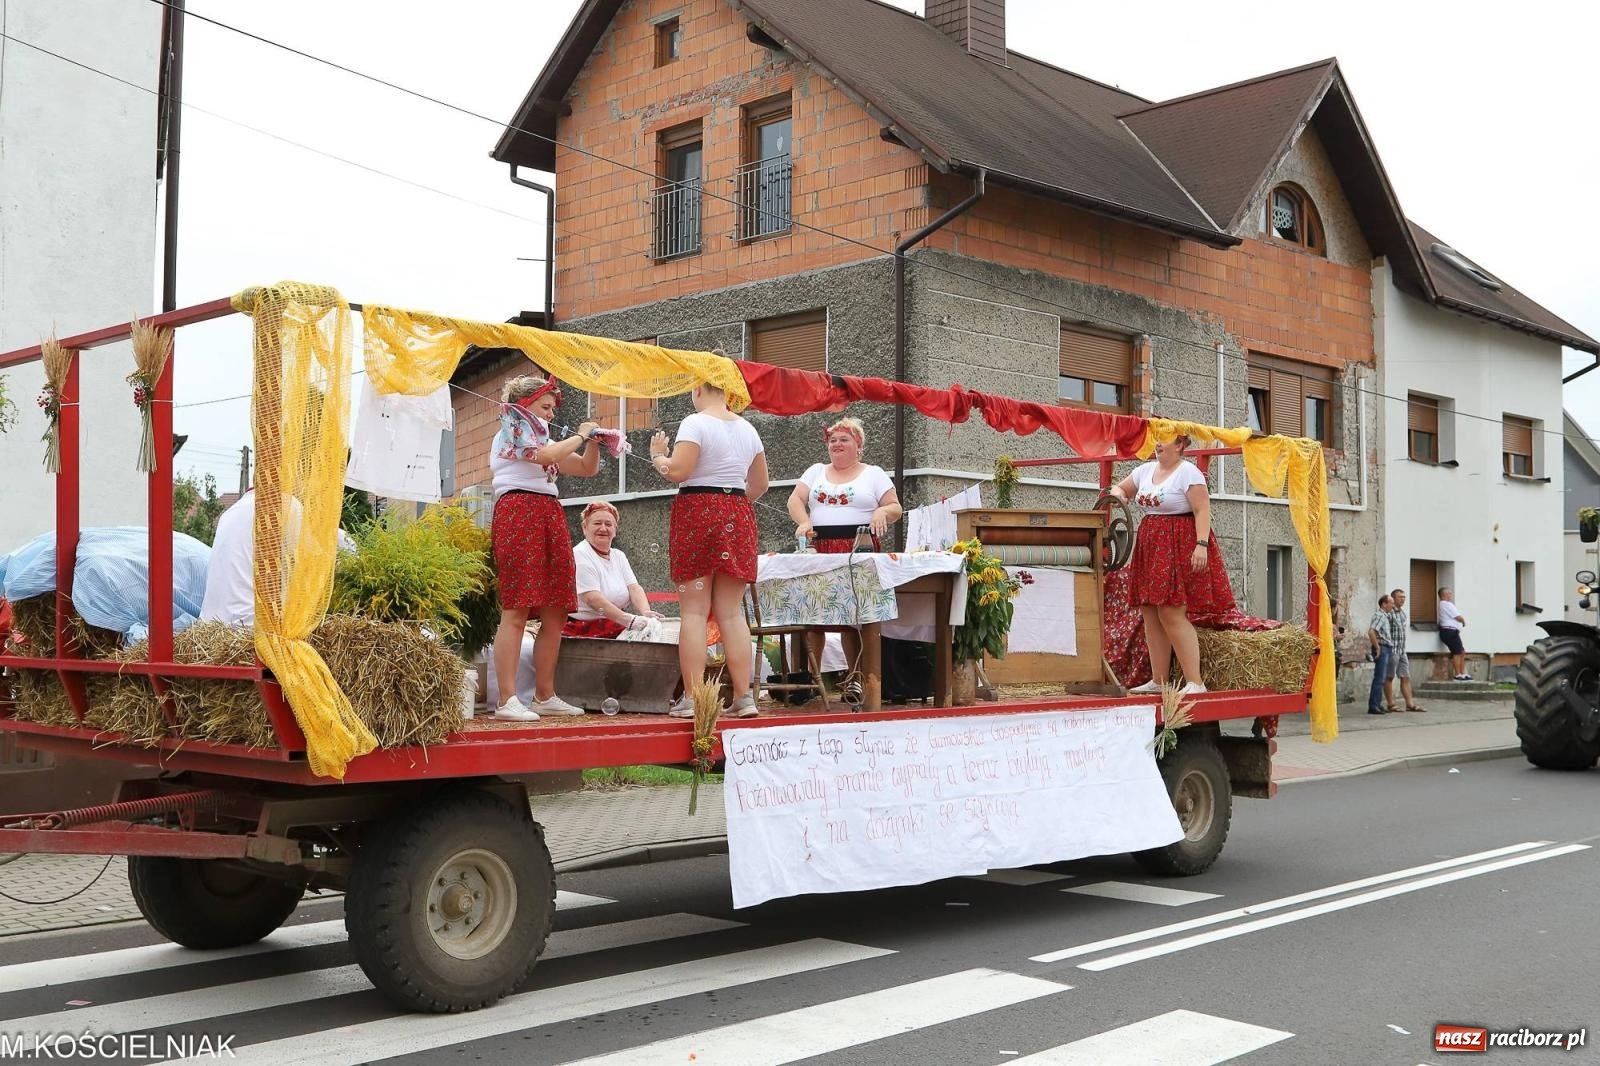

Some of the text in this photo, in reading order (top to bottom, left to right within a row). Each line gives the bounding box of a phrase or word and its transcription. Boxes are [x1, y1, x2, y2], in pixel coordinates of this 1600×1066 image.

[730, 734, 788, 766] Gamów
[799, 738, 808, 757] z
[817, 730, 843, 764] tego
[855, 730, 895, 768] słynie
[905, 732, 918, 755] że
[835, 769, 884, 808] pranie
[947, 765, 957, 785] a
[962, 753, 1000, 783] teraz
[826, 820, 849, 846] na
[866, 807, 925, 853] dożynki
